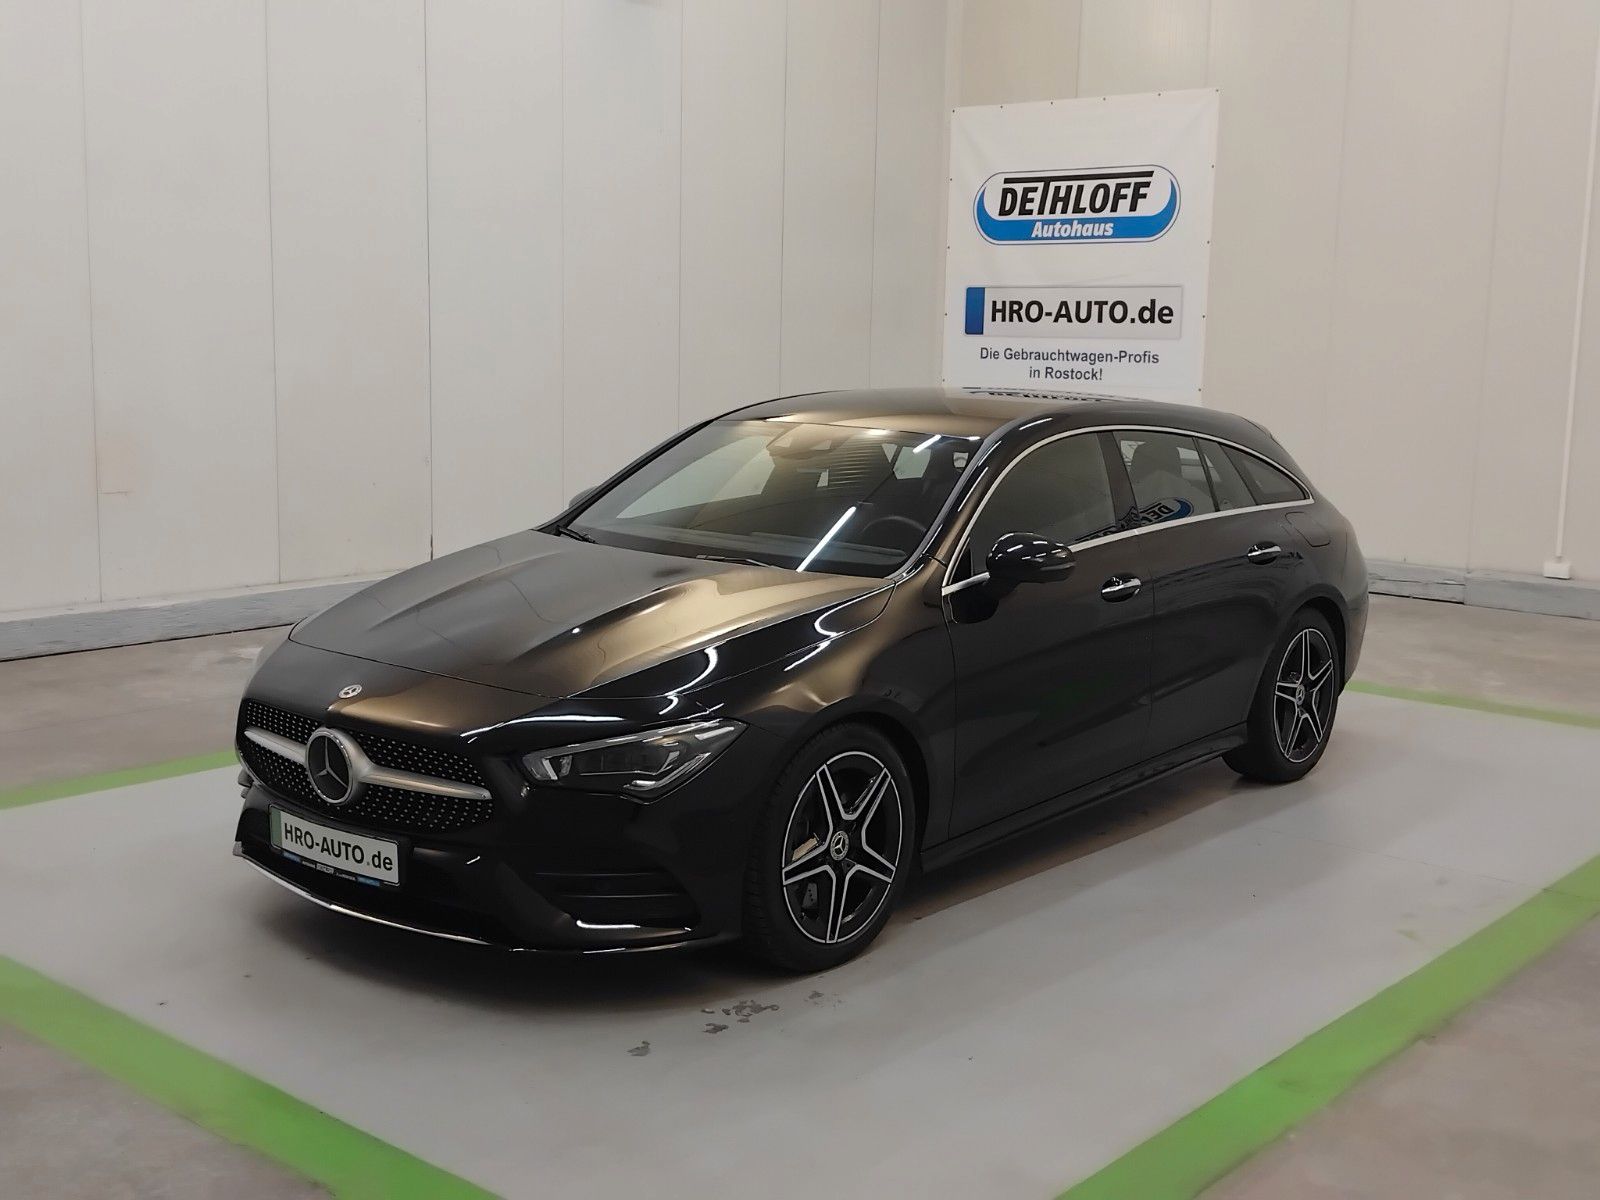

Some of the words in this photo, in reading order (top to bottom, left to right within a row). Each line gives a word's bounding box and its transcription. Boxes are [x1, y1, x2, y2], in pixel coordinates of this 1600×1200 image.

[999, 170, 1154, 216] DETHLOFF
[1032, 220, 1114, 238] Autohaus
[991, 299, 1174, 324] HRO-AUTO.de
[980, 347, 1000, 360] Die
[1003, 347, 1160, 364] Gebrauchtwagen-Profis
[1029, 367, 1040, 379] in
[1044, 367, 1103, 381] Rostock!
[284, 822, 393, 872] HRO-AUTO.de
